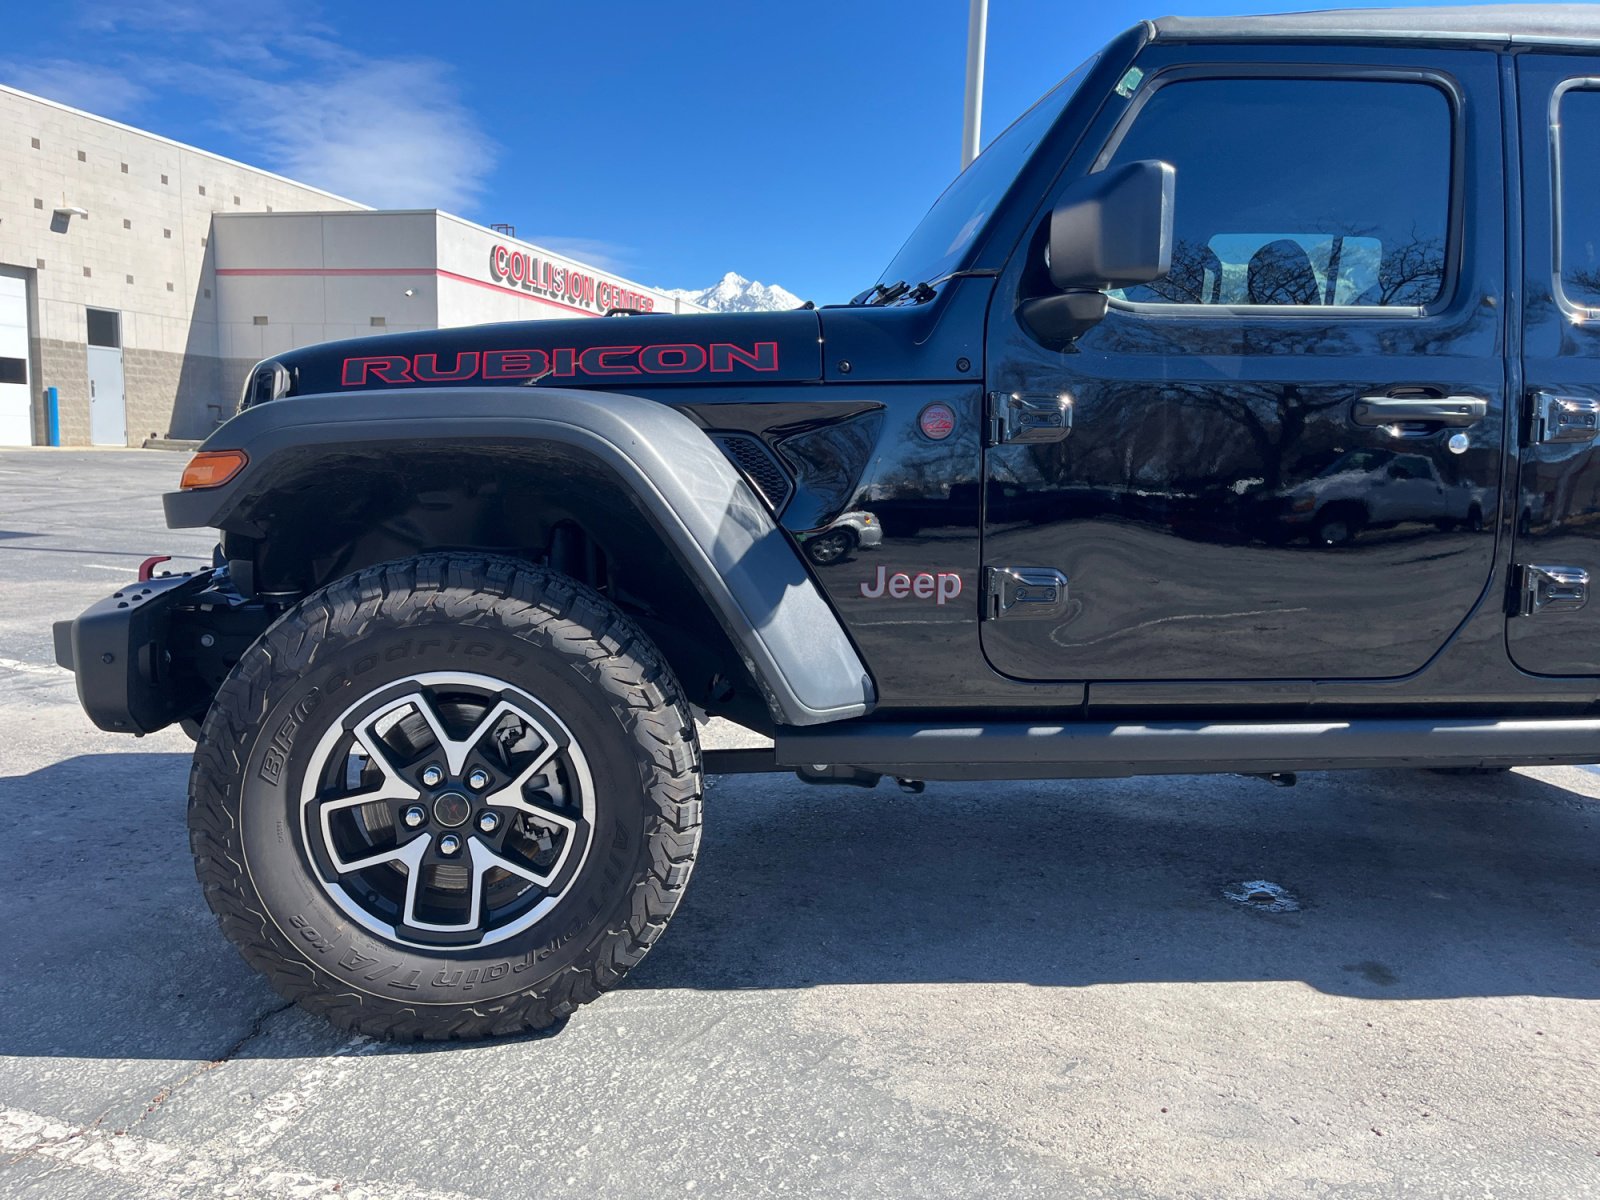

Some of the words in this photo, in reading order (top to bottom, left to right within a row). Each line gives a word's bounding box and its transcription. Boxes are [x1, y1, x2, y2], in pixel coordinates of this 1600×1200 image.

[493, 245, 595, 303] COLLISION
[599, 281, 655, 312] CENTER
[341, 341, 779, 386] RUBICON
[860, 566, 962, 605] Jeep
[258, 636, 527, 787] BFGoodrich
[288, 913, 336, 954] KO2
[337, 945, 423, 991] T/A
